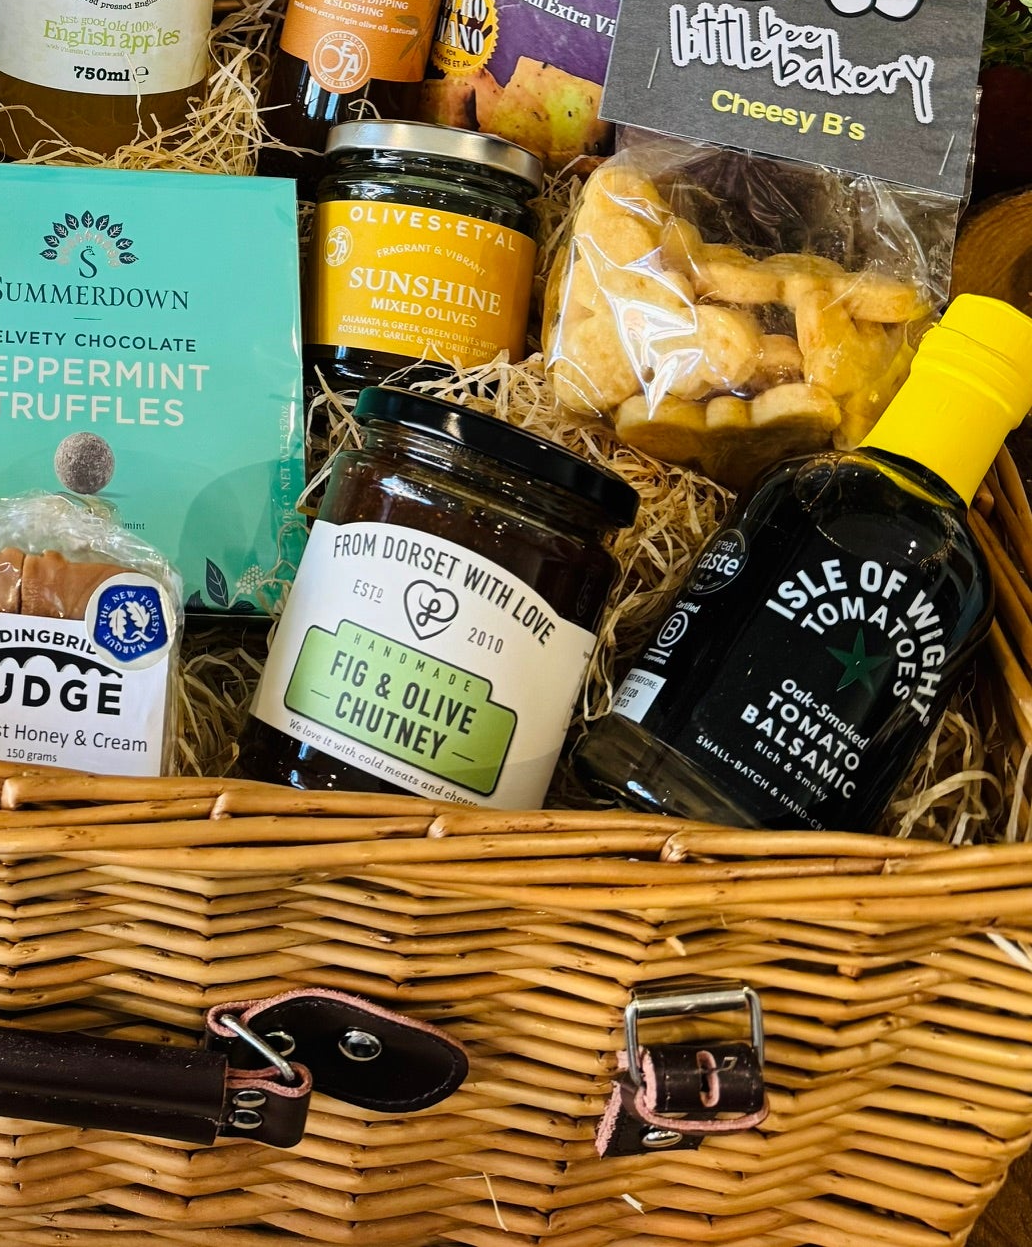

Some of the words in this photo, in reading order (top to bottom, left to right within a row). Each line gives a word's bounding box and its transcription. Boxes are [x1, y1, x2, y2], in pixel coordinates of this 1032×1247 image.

[100, 2, 132, 10] pressed
[672, 7, 771, 65] little
[764, 10, 824, 45] bee
[73, 65, 130, 82] 750ml
[777, 33, 929, 120] bakery
[711, 89, 816, 134] Cheesy
[376, 244, 432, 258] FRAGRANT
[349, 266, 501, 316] SUNSHINE
[371, 297, 422, 317] MIXED
[425, 306, 477, 328] OLIVES
[74, 333, 197, 353] CHOCOLATE
[333, 534, 376, 558] FROM
[383, 536, 461, 580] DORSET
[463, 563, 514, 609] WITH
[512, 596, 556, 647] LOVE
[353, 633, 472, 693] HANDMADE
[765, 558, 848, 621] ISLE
[859, 560, 908, 600] OF
[905, 589, 946, 723] WIGHT
[800, 596, 917, 701] TOMATOES
[329, 650, 369, 688] FIG
[375, 673, 392, 700] &
[401, 682, 477, 735] OLIVE
[781, 678, 871, 751] Oak-Smoked
[6, 748, 25, 759] 150
[27, 751, 58, 763] grams
[15, 724, 69, 748] Honey
[74, 730, 87, 746] &
[92, 732, 148, 752] Cream
[335, 693, 448, 760] CHUTNEY
[740, 704, 857, 800] BALSAMIC
[766, 691, 861, 772] TOMATO
[695, 734, 770, 790] SMALL-BATCH
[753, 741, 782, 764] Rich
[795, 770, 828, 802] Smoky
